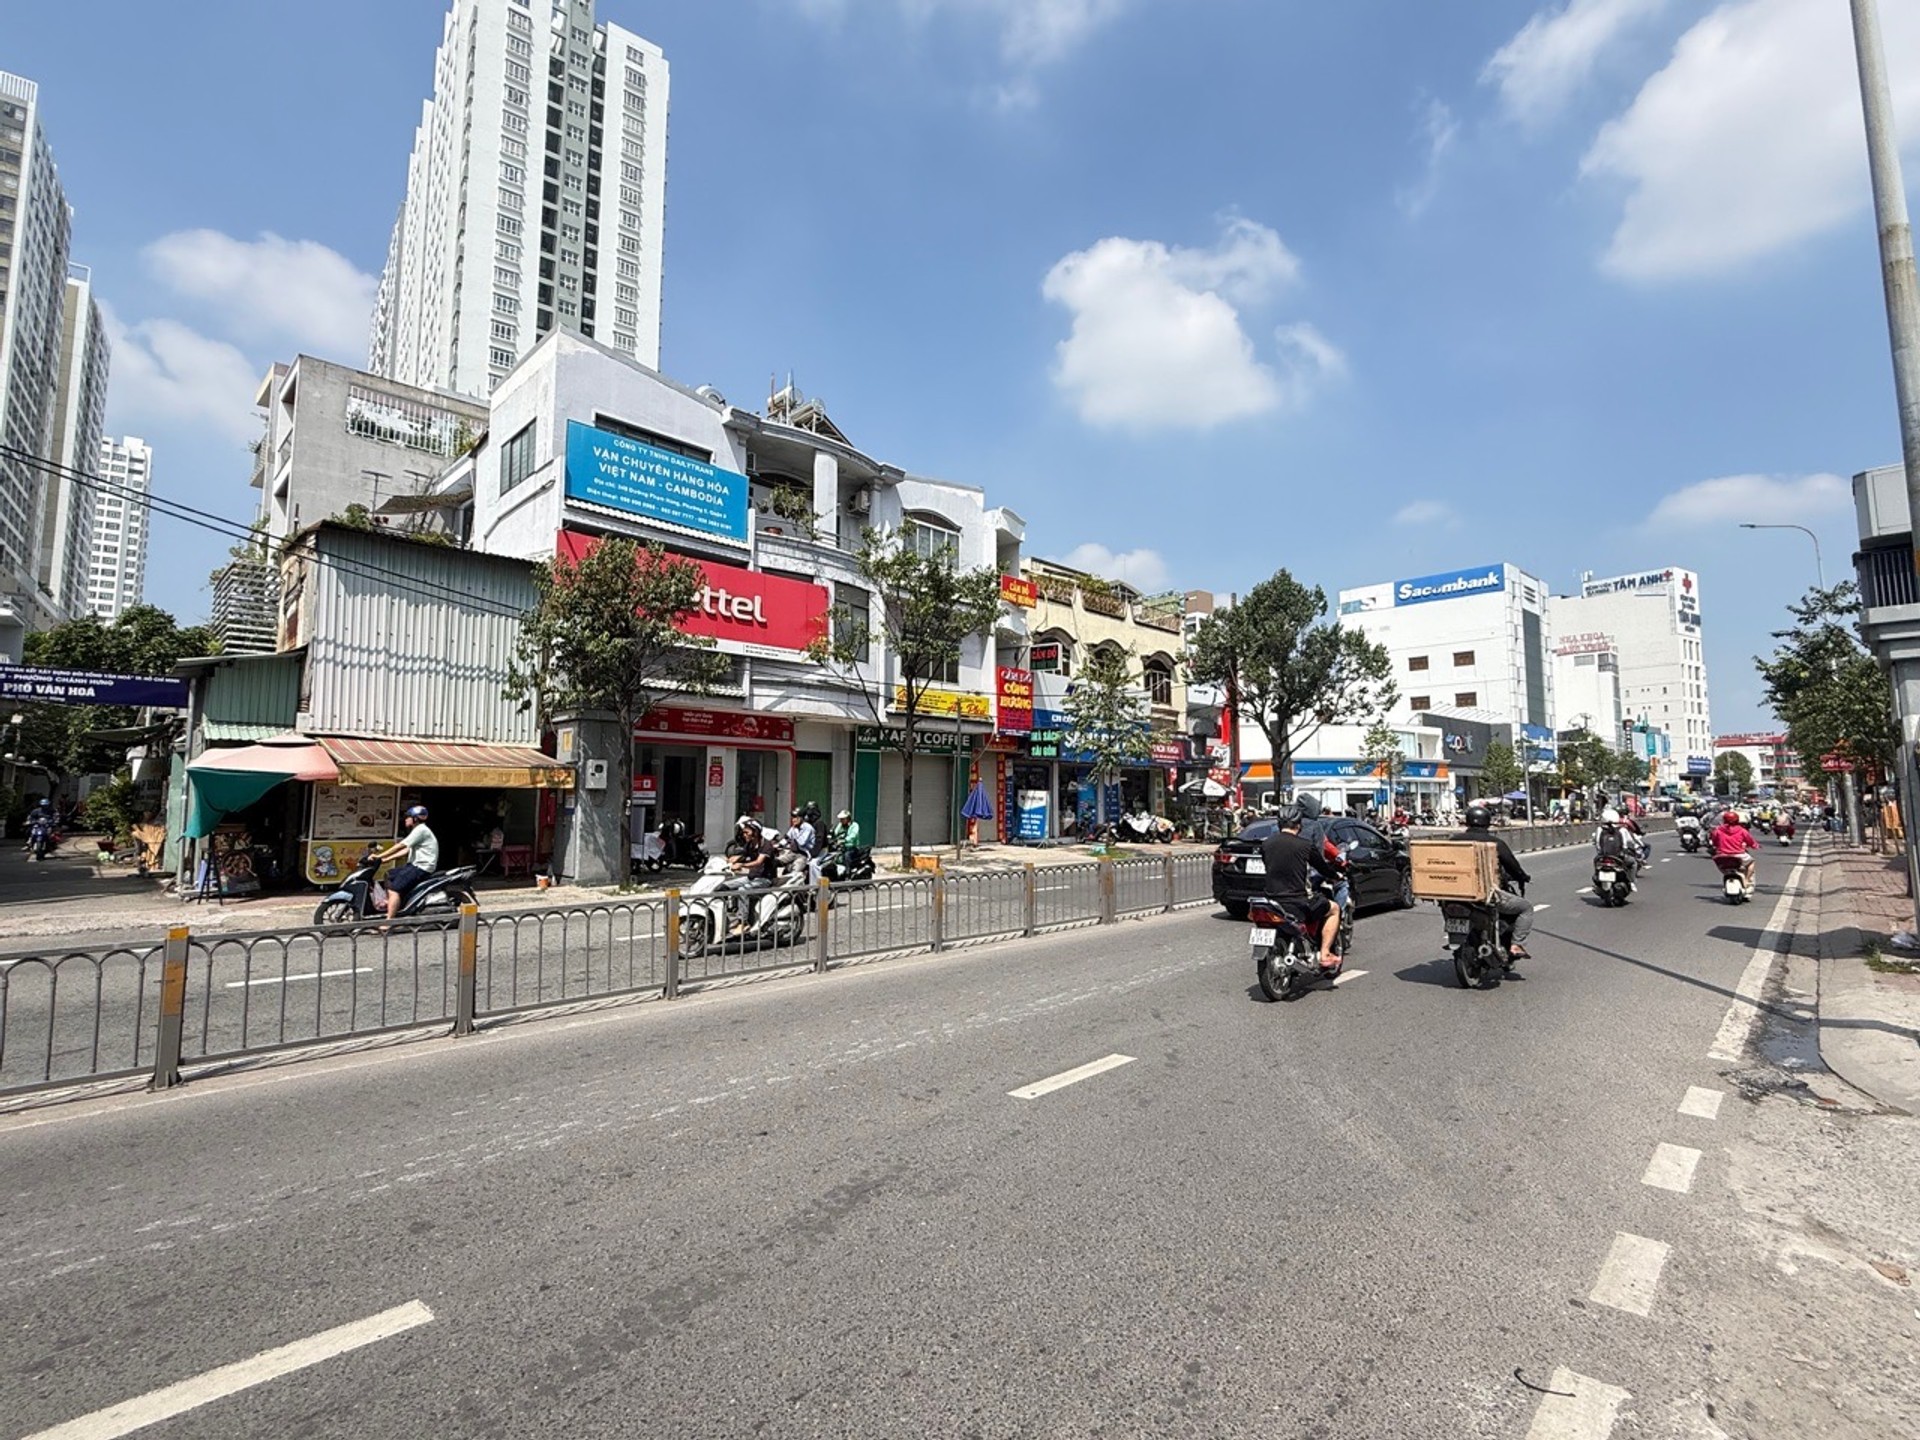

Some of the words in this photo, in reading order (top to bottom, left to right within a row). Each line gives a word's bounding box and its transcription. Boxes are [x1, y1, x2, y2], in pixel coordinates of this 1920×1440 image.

[614, 439, 636, 451] CÔNG
[638, 446, 648, 455] TY
[599, 462, 626, 478] VIỆT
[630, 471, 655, 487] NAM
[665, 482, 724, 506] CAMBODIA
[673, 471, 704, 487] HÀNG
[1399, 571, 1499, 600] Sacombank
[1613, 578, 1636, 592] TÂM
[1638, 573, 1663, 587] ANH
[3, 681, 33, 693] PHỐ
[36, 683, 66, 695] VĂN
